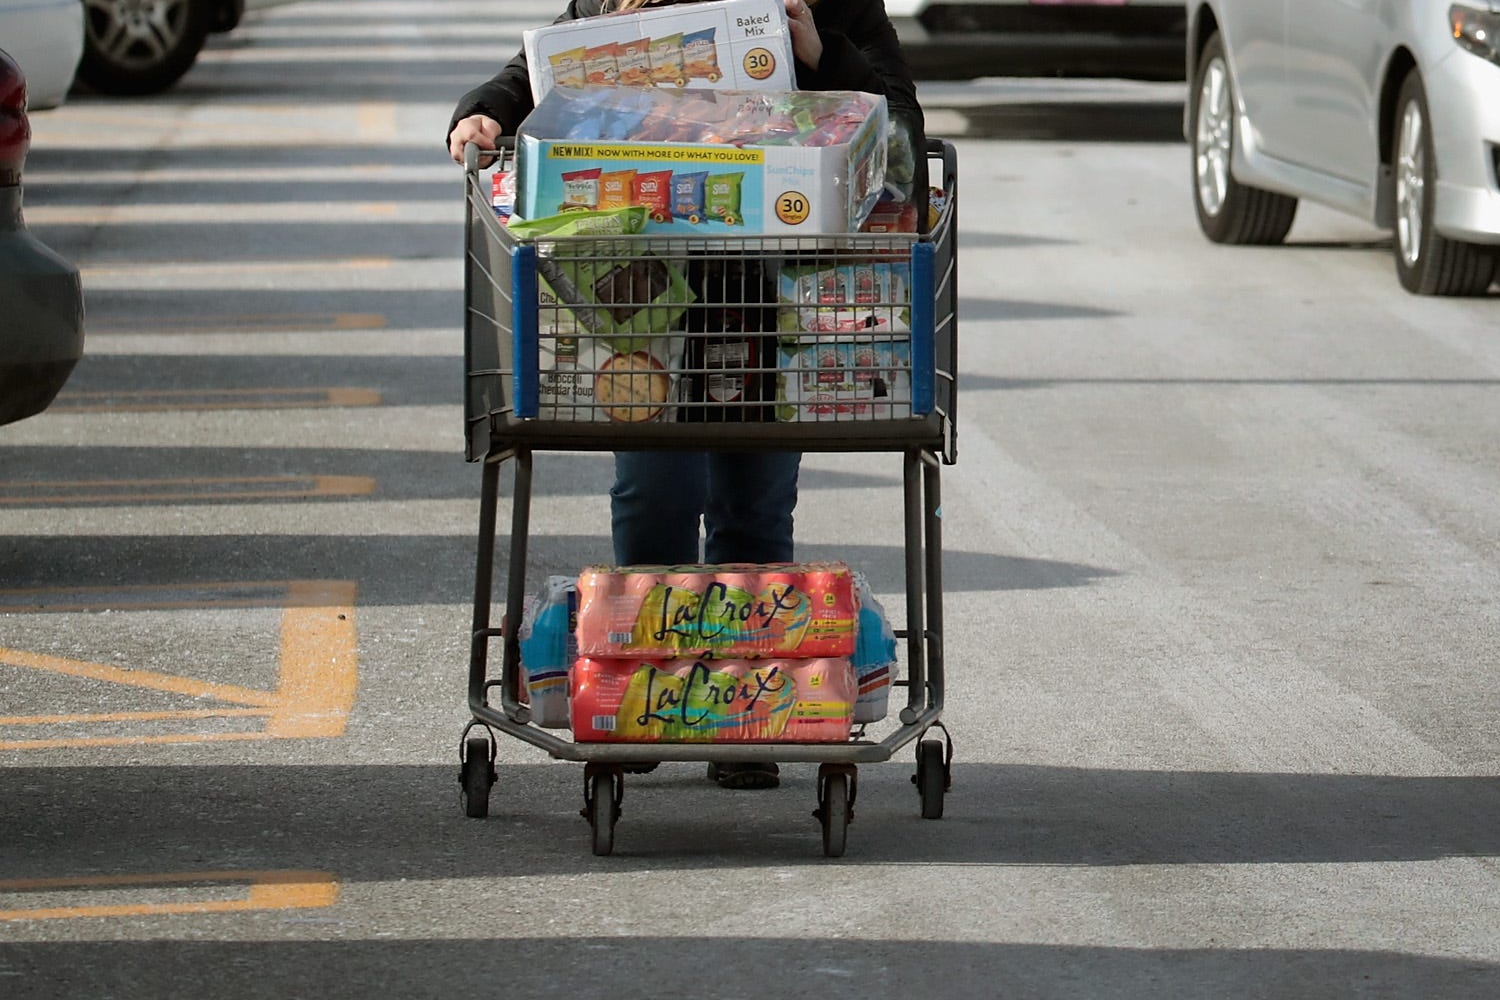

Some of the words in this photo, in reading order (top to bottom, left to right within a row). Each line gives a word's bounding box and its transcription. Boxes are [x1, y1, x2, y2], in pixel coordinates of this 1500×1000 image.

[736, 12, 770, 27] Baked
[745, 26, 765, 37] Mix
[749, 54, 768, 68] 30
[552, 146, 572, 157] NEW
[573, 146, 593, 157] MIX!
[622, 149, 645, 157] WITH
[646, 150, 672, 158] MORE
[673, 150, 685, 159] OF
[686, 151, 713, 160] WHAT
[714, 152, 733, 160] YOU
[734, 153, 760, 161] LOVE!
[782, 199, 803, 213] 30
[654, 581, 801, 641] LaCroix
[636, 662, 786, 726] LaCroix
